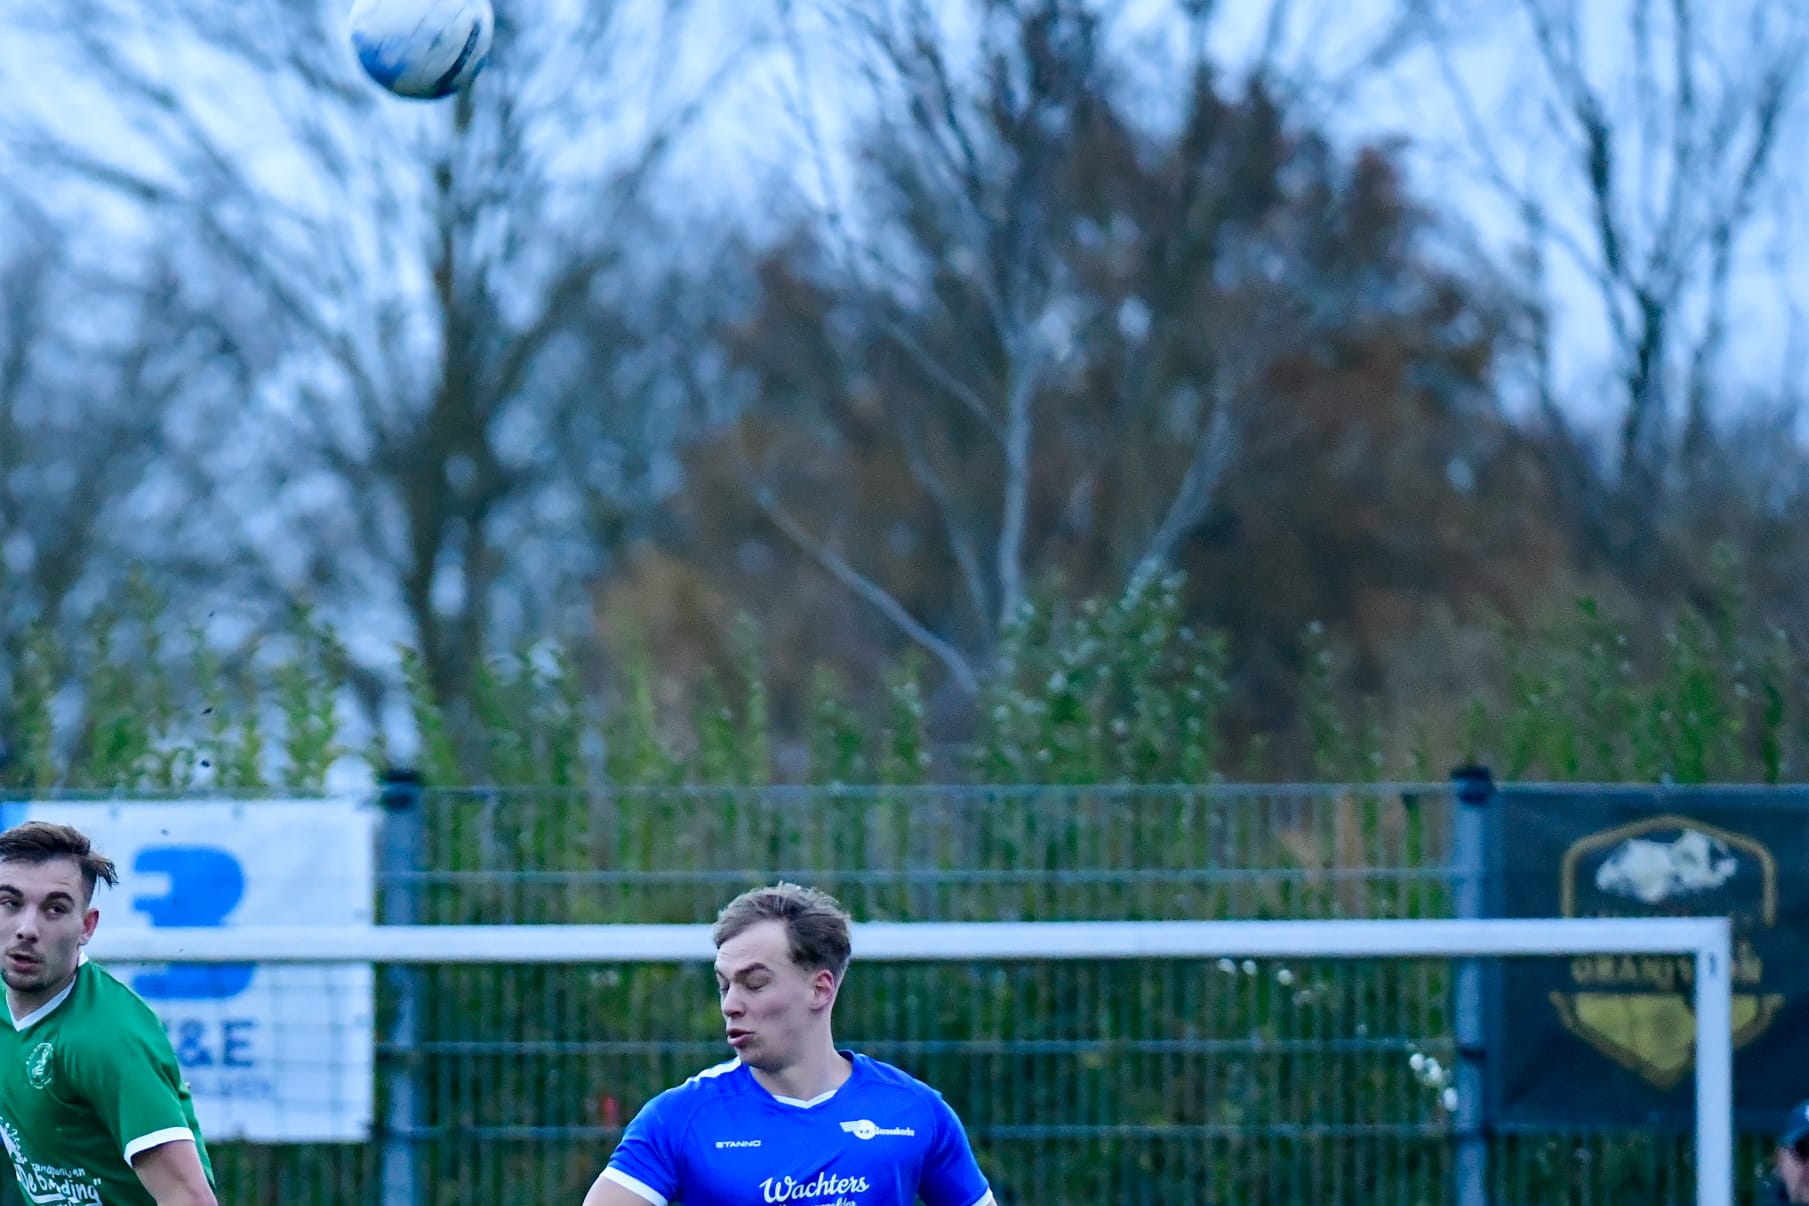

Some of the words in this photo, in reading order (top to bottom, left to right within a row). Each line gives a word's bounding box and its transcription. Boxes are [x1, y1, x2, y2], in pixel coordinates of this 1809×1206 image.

[162, 1018, 256, 1068] &E
[715, 1140, 761, 1148] STANNO
[759, 1172, 869, 1203] Wachters
